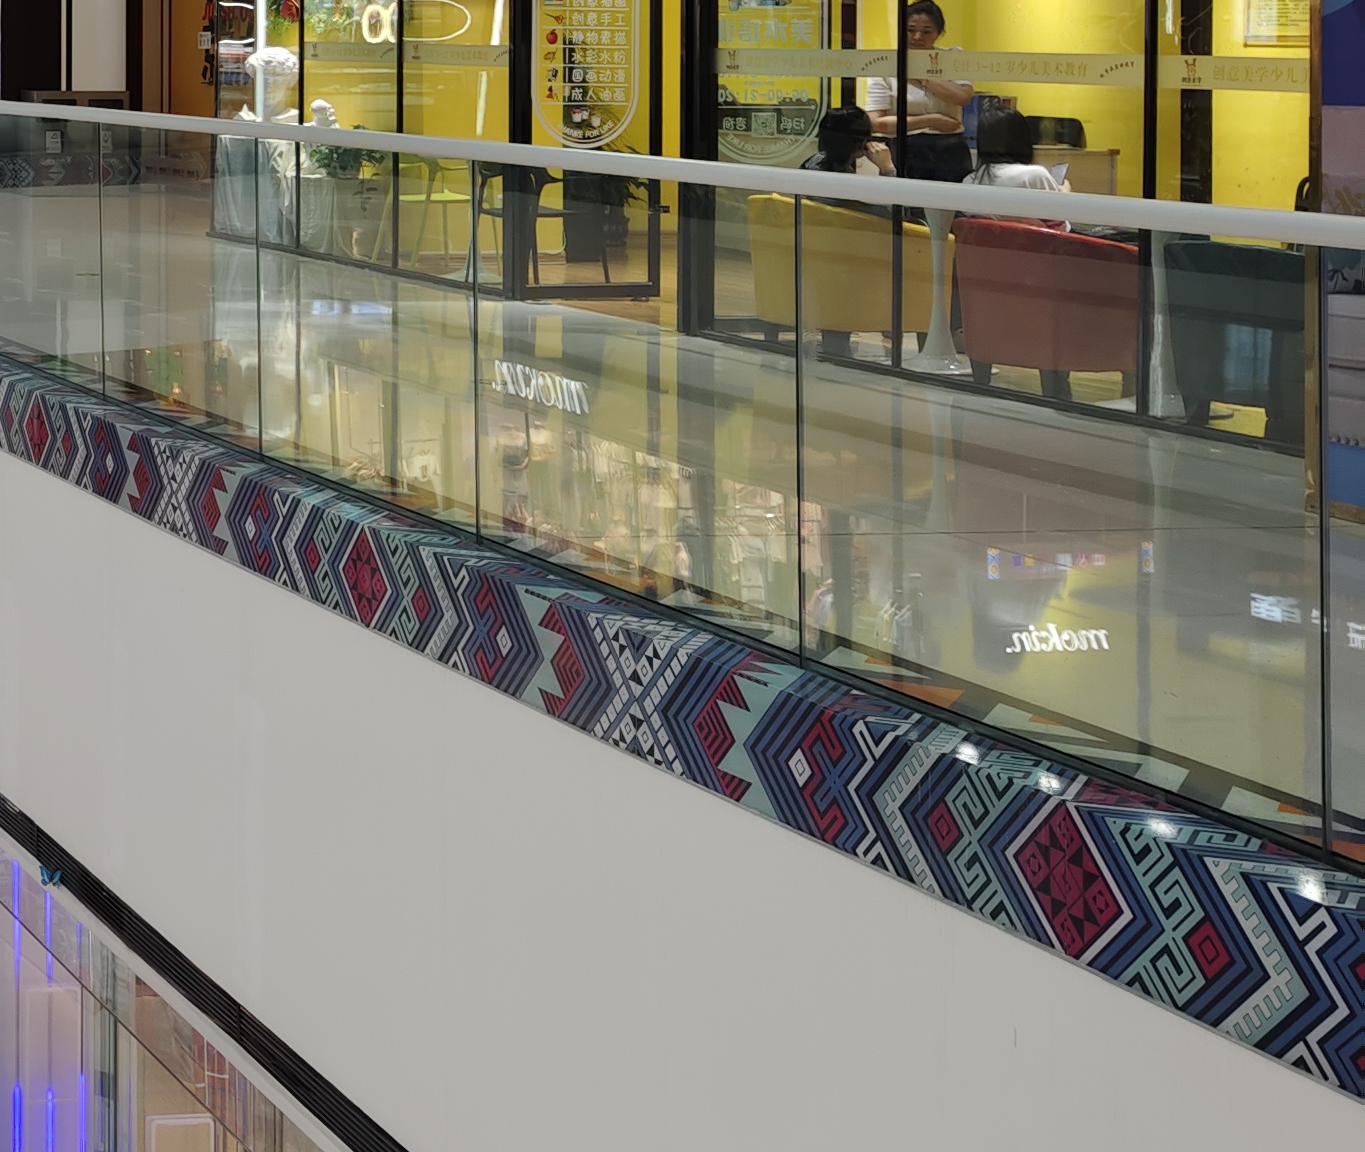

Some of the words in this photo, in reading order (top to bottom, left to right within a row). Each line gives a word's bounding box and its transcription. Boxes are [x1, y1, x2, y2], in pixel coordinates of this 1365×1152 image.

[572, 12, 626, 26] 创意手工
[571, 48, 626, 63] 水彩水粉
[571, 87, 626, 101] 成人油画
